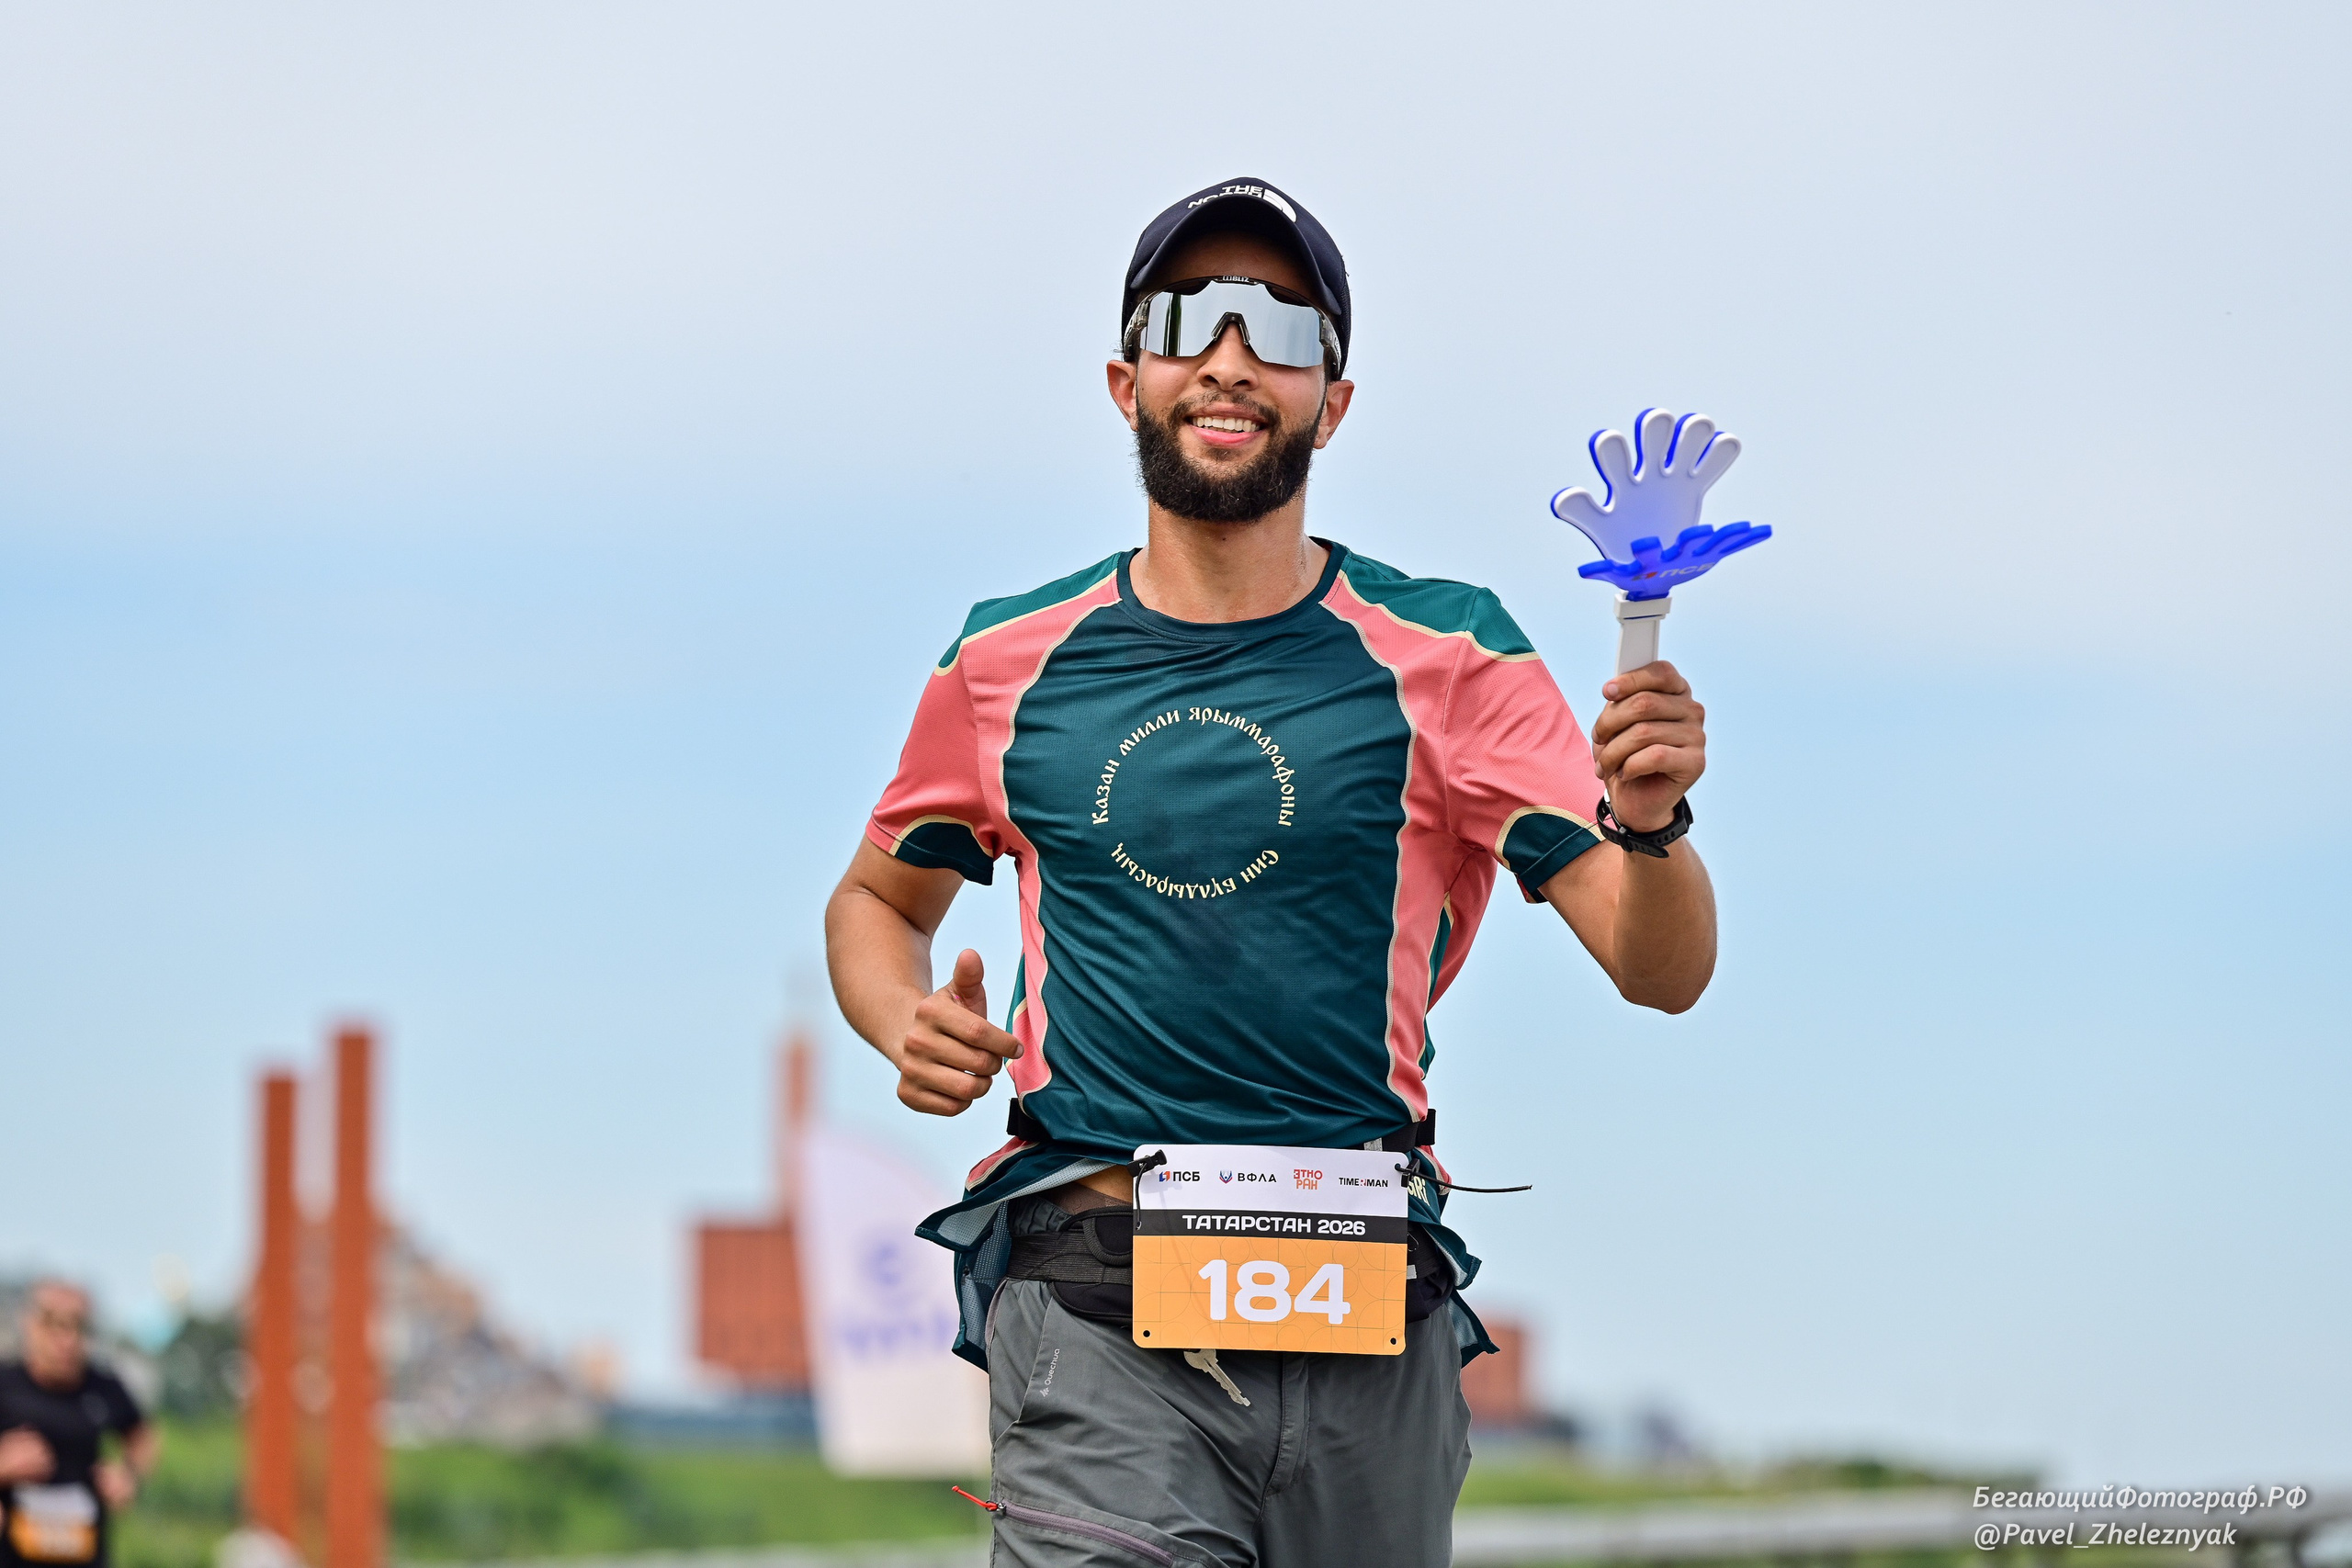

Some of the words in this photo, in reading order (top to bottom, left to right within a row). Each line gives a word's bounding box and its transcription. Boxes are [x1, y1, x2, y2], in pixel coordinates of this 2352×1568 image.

[1222, 185, 1263, 194] THE
[1091, 759, 1120, 825] Казан
[1119, 710, 1181, 756] милли
[1240, 850, 1279, 884] Син
[1172, 1171, 1201, 1182] ПСБ
[1238, 1172, 1277, 1183] ВФЛА
[1182, 1214, 1312, 1234] ТАТАРСТАН
[1317, 1218, 1366, 1235] 2026
[1197, 1258, 1351, 1325] 184
[1044, 1348, 1060, 1386] Quechua
